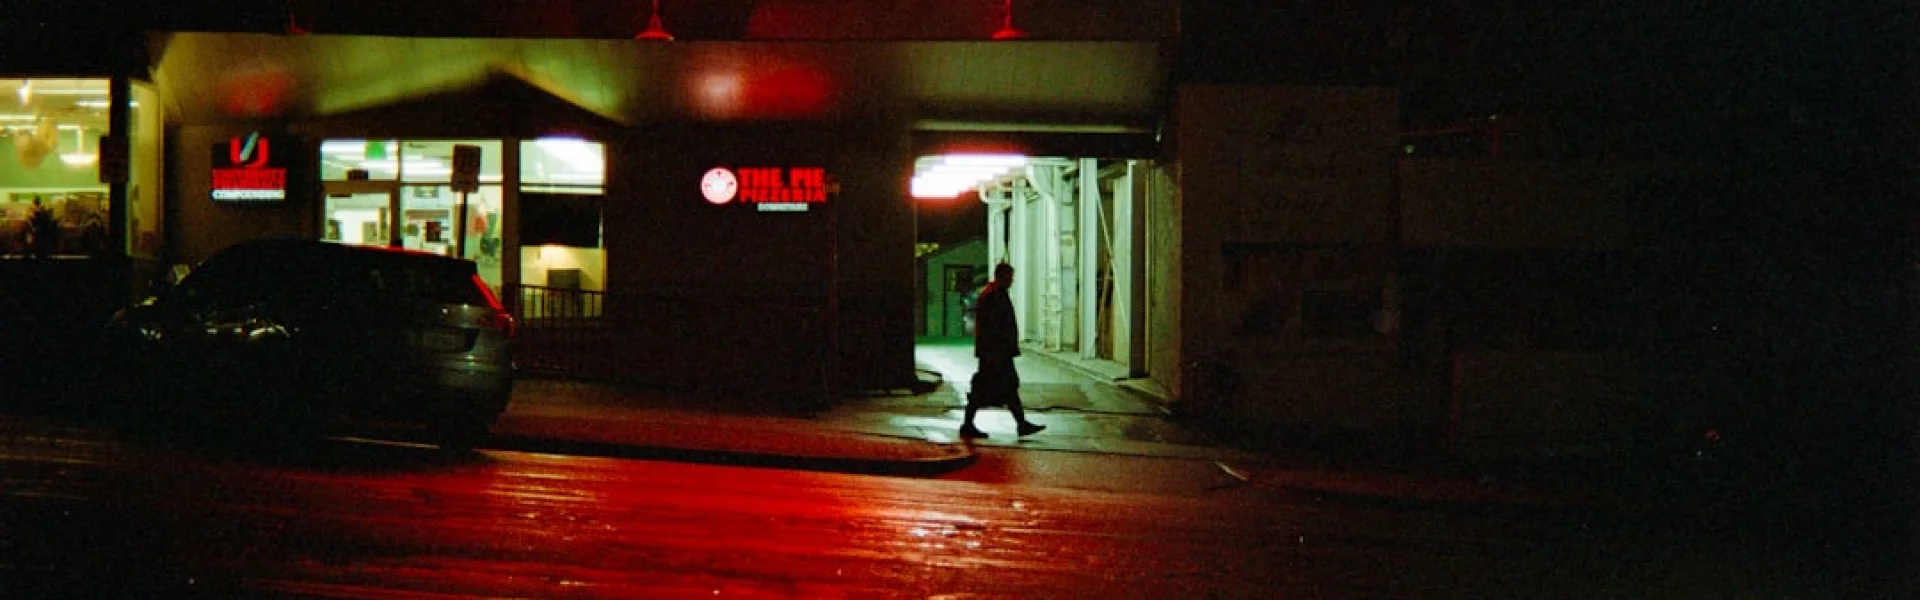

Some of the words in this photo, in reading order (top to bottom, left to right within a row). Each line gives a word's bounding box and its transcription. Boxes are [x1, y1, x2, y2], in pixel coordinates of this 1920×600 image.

[738, 168, 783, 187] THE
[790, 168, 825, 187] PIE
[738, 187, 827, 202] PIZZERIA
